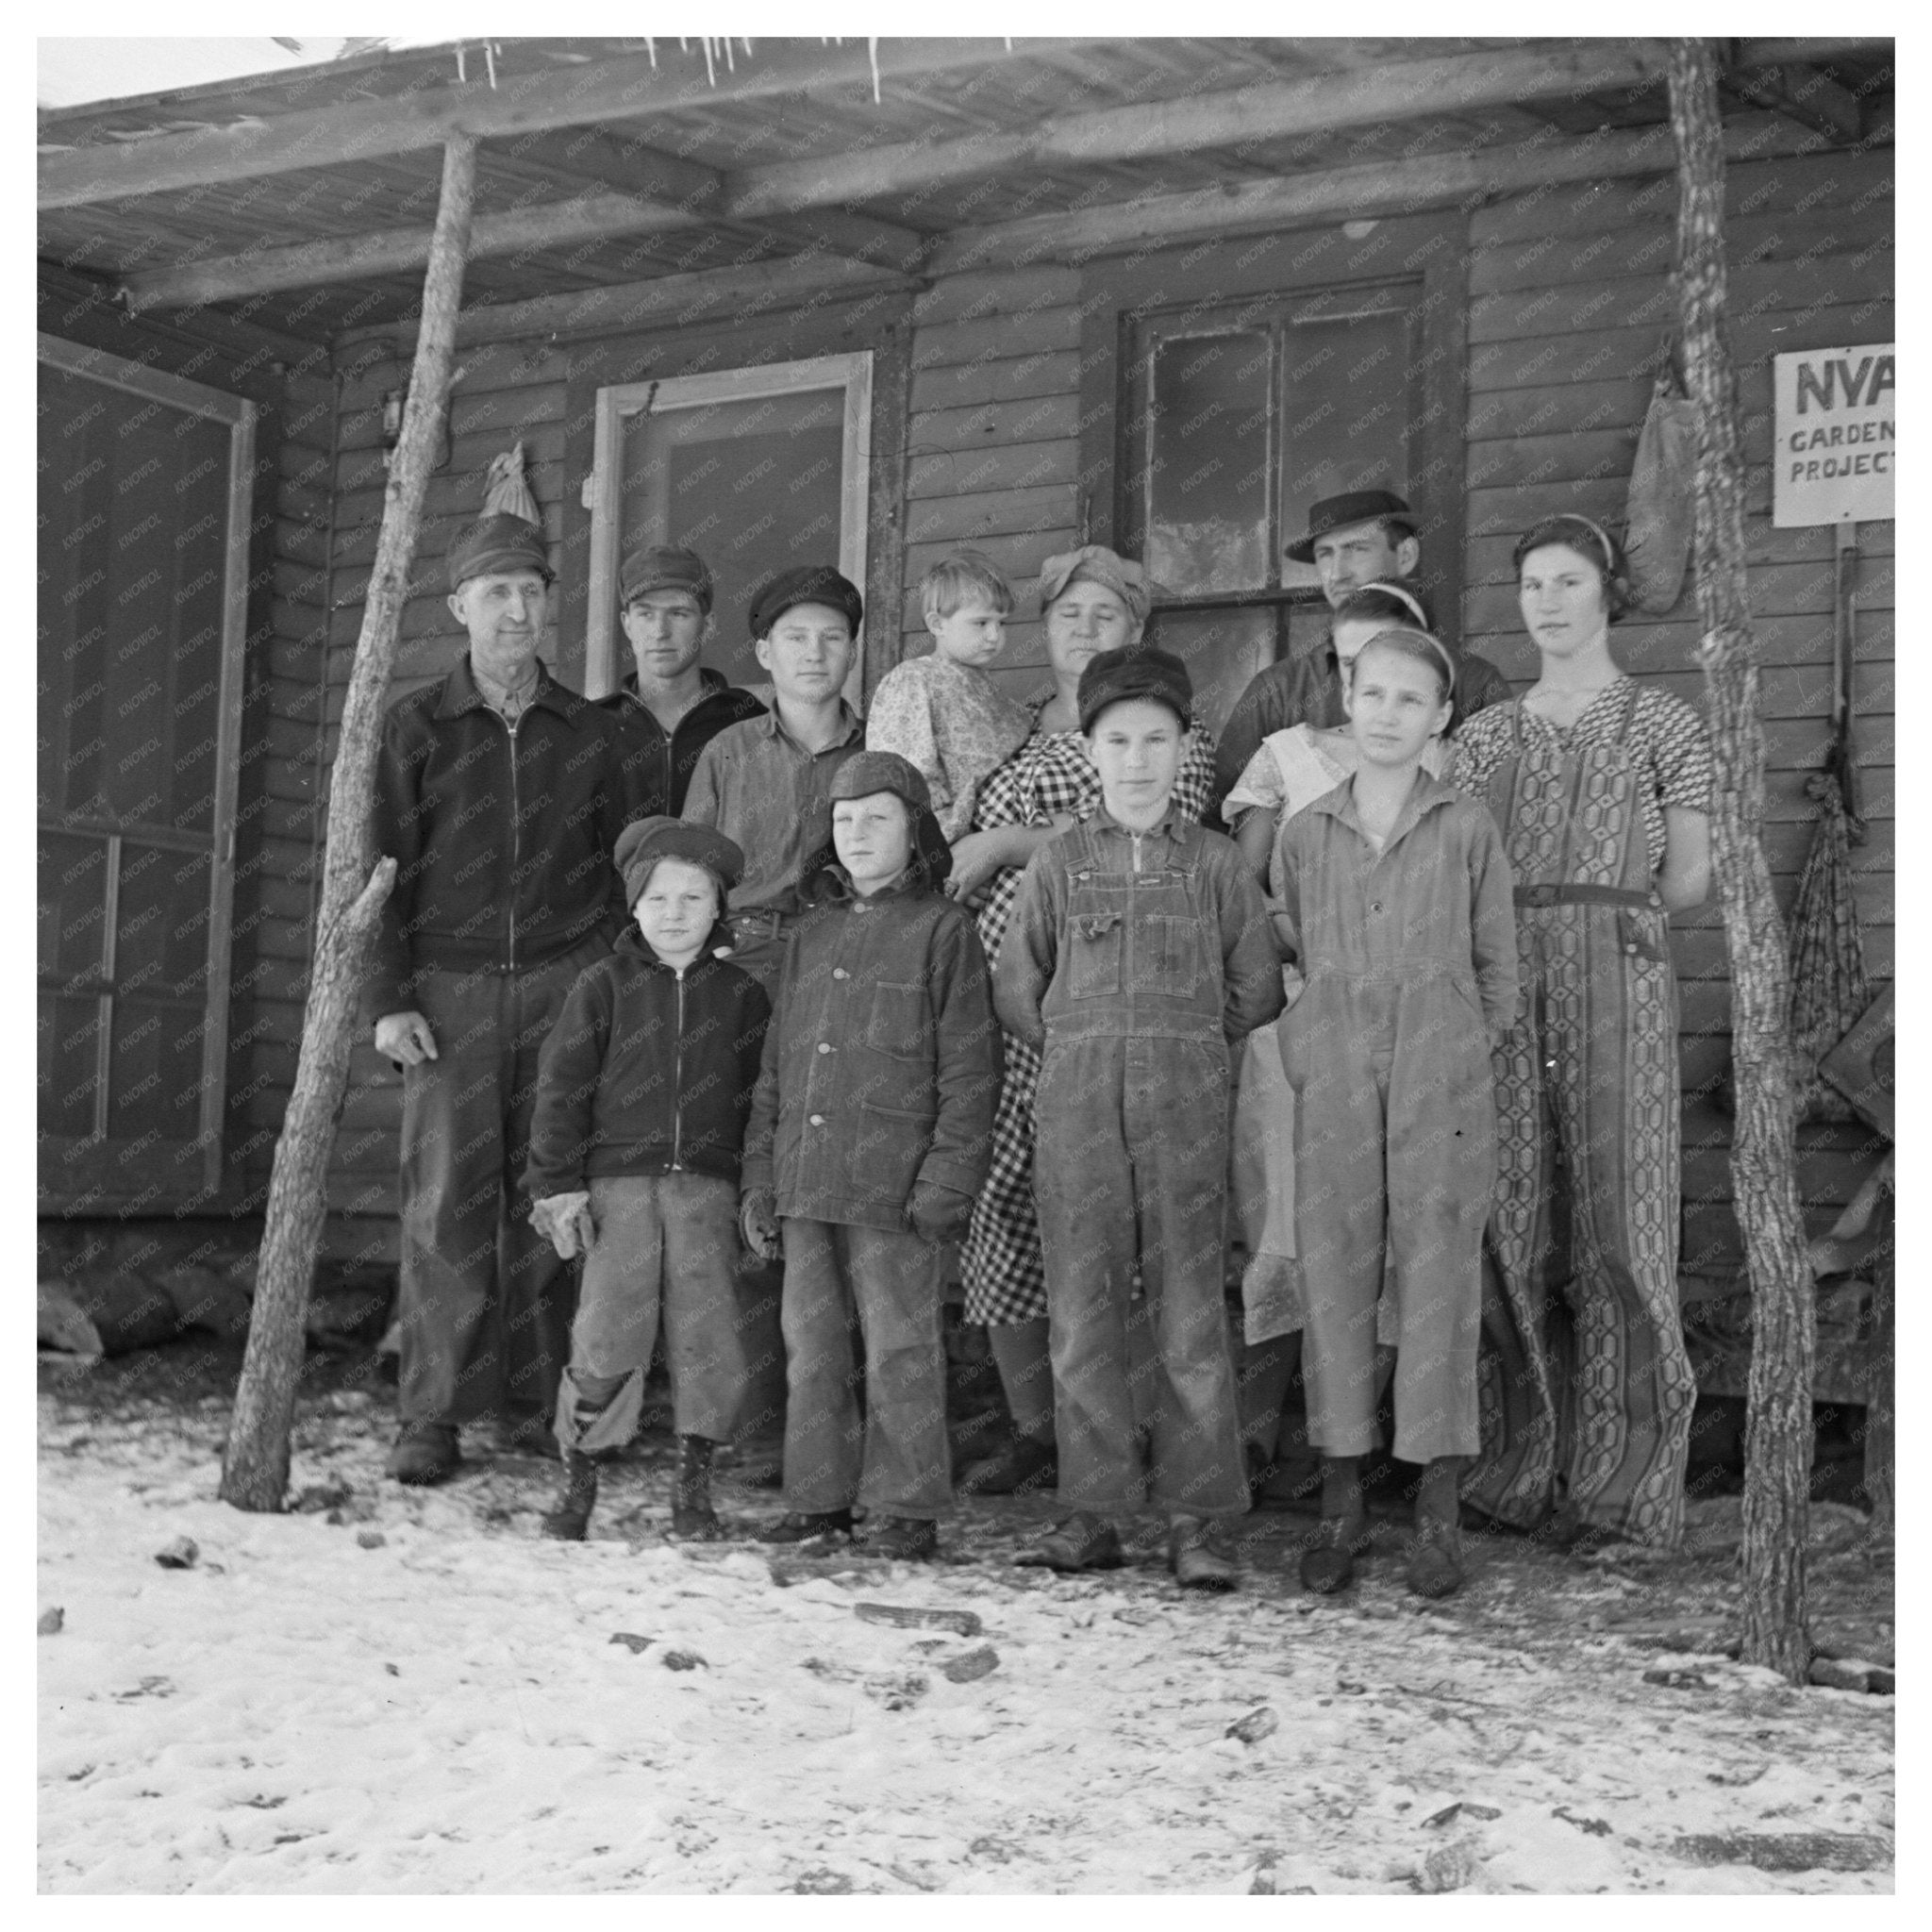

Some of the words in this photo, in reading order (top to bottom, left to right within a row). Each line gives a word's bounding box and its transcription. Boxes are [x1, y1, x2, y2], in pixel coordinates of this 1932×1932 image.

[1797, 355, 1895, 414] NYA
[1790, 421, 1895, 453] GARDEN
[1791, 451, 1895, 482] PROJEC
